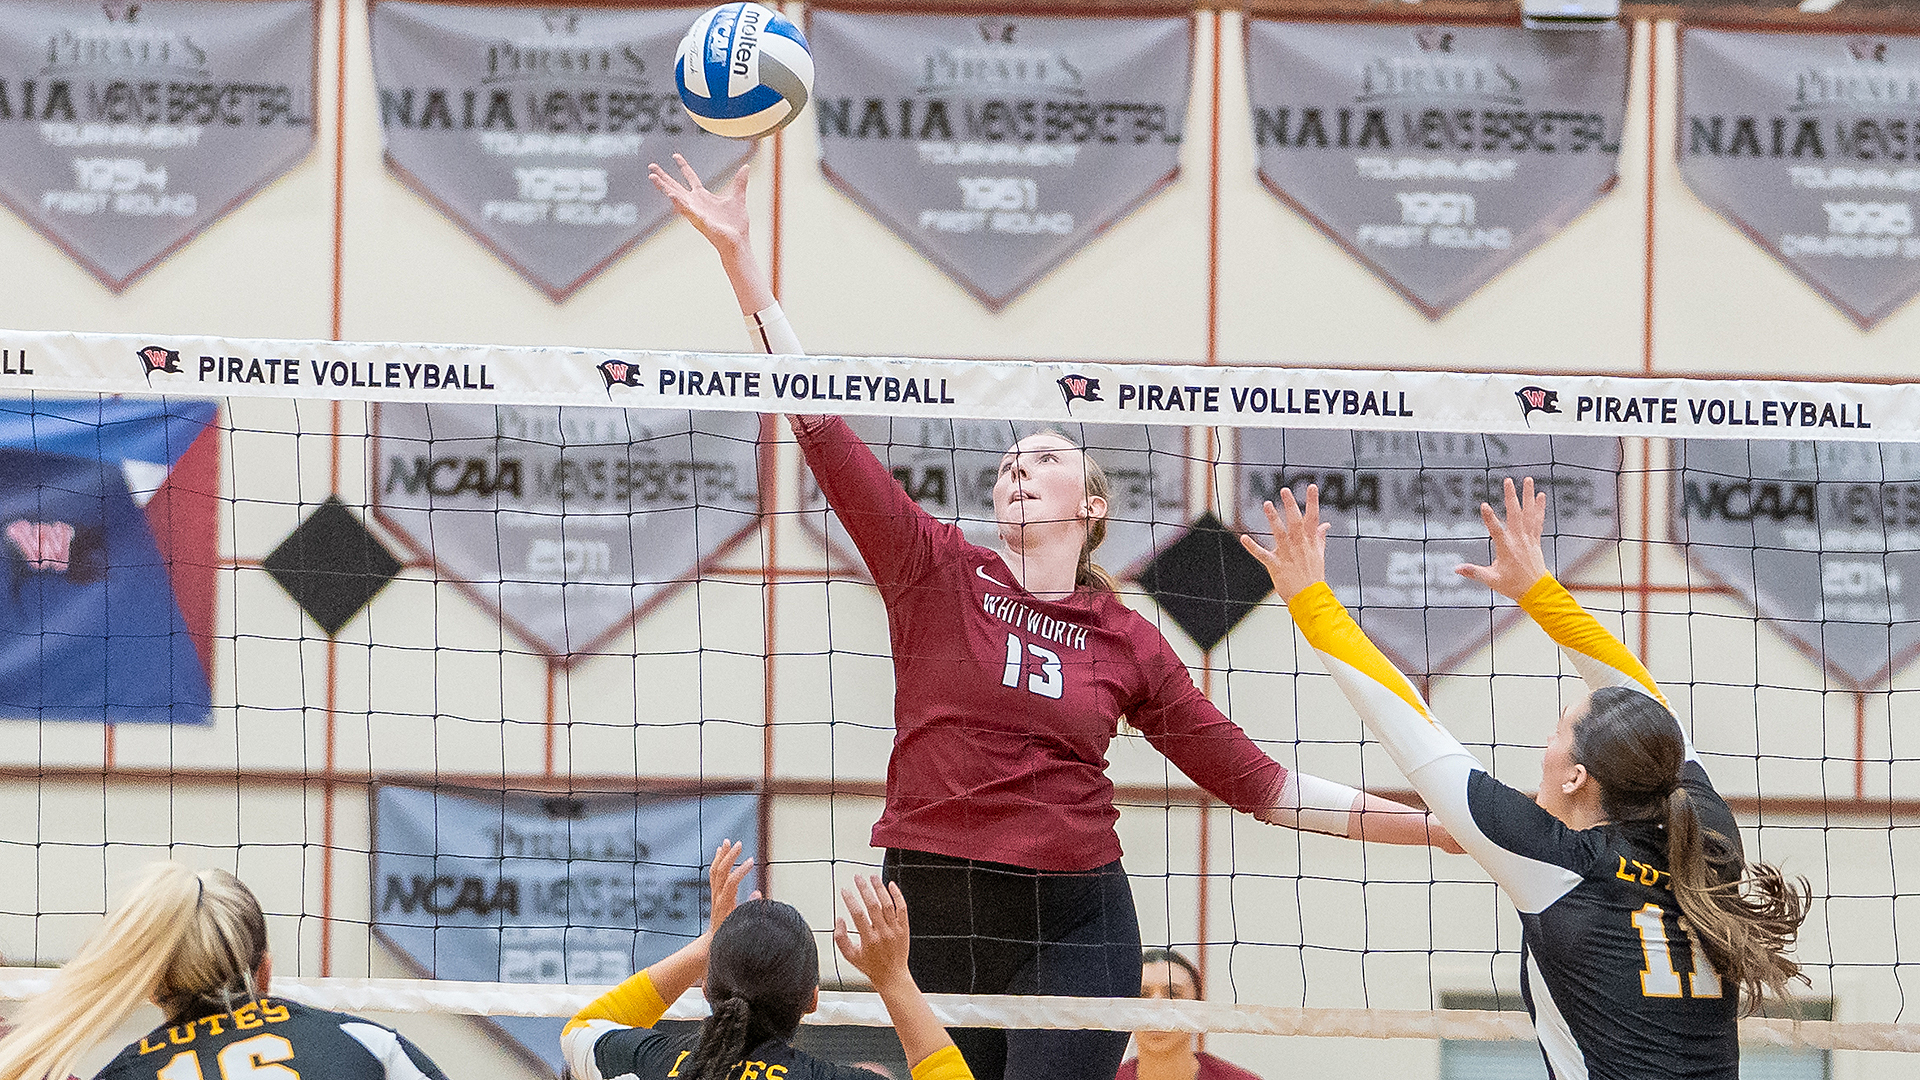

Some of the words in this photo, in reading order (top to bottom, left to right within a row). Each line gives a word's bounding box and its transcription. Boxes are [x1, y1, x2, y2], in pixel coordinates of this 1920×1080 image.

[733, 10, 760, 76] molten
[0, 80, 76, 121] IA
[380, 89, 515, 130] NAIA
[818, 99, 951, 140] NAIA
[1255, 108, 1392, 149] NAIA
[1690, 117, 1826, 160] NAIA
[199, 355, 299, 386] PIRATE
[311, 360, 495, 390] VOLLEYBALL
[658, 369, 760, 398] PIRATE
[770, 373, 955, 404] VOLLEYBALL
[1119, 384, 1220, 412] PIRATE
[1231, 387, 1413, 417] VOLLEYBALL
[1577, 396, 1677, 424] PIRATE
[1688, 399, 1872, 429] VOLLEYBALL
[386, 457, 522, 499] NCAA
[1681, 481, 1815, 523] NCAA
[983, 592, 1088, 650] WHITWORTH
[1002, 632, 1064, 699] 13
[382, 875, 519, 917] NCAA
[1631, 902, 1723, 998] 11
[139, 998, 291, 1055] LUTES
